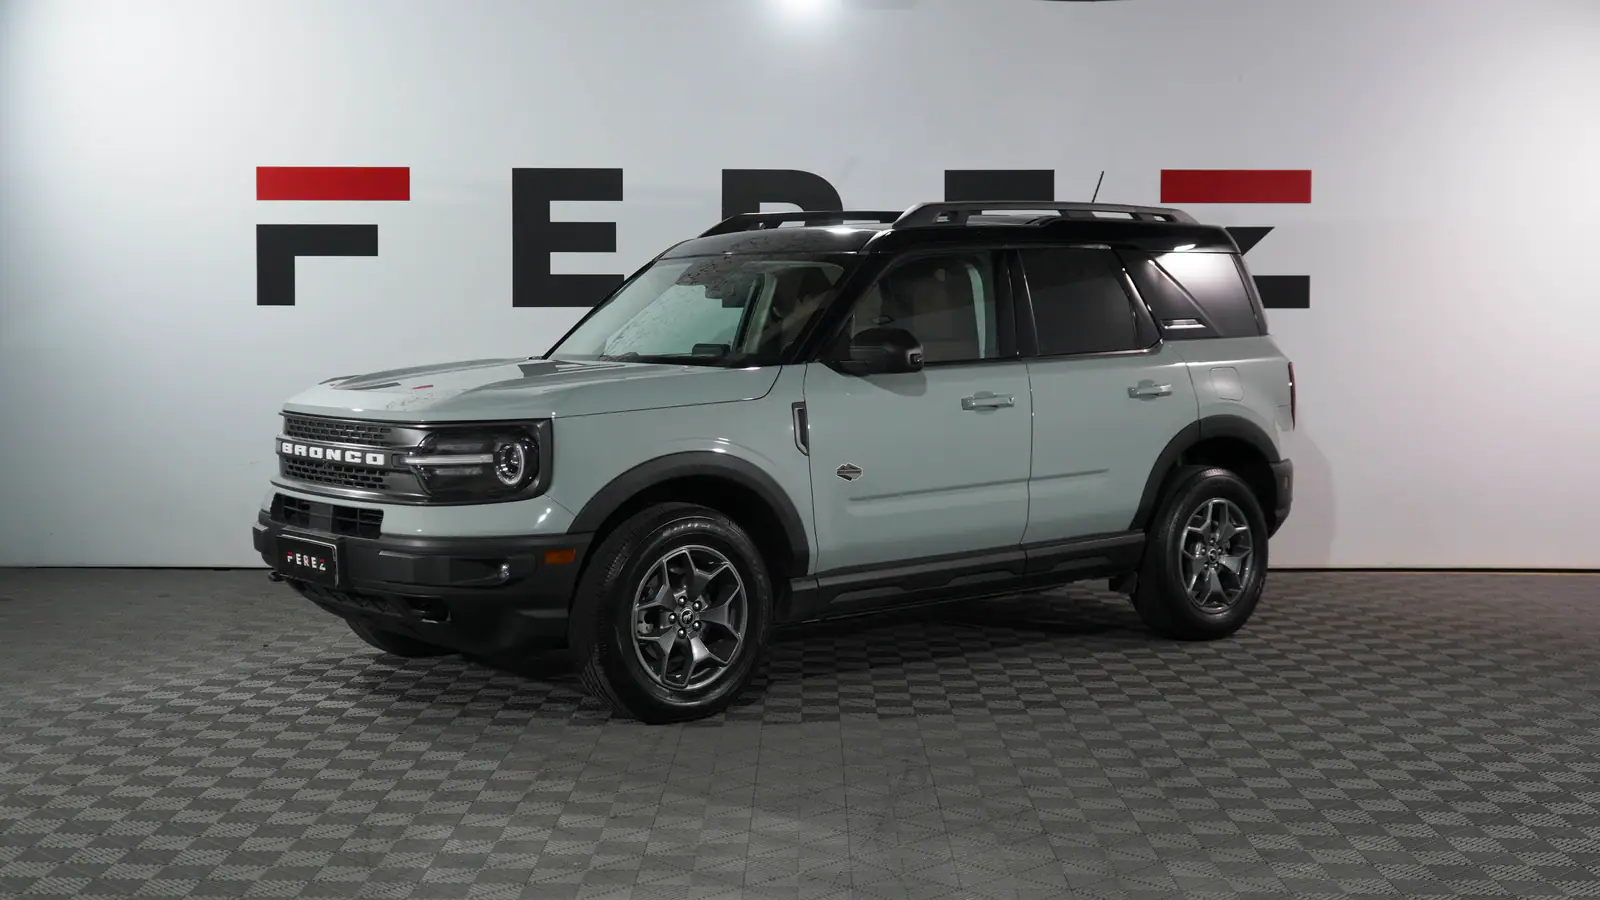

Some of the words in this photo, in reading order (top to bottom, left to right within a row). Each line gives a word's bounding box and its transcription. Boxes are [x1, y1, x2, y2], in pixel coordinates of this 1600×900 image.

[256, 166, 1311, 307] FEZ
[282, 442, 385, 466] BRONCO
[287, 551, 326, 571] FEREZ
